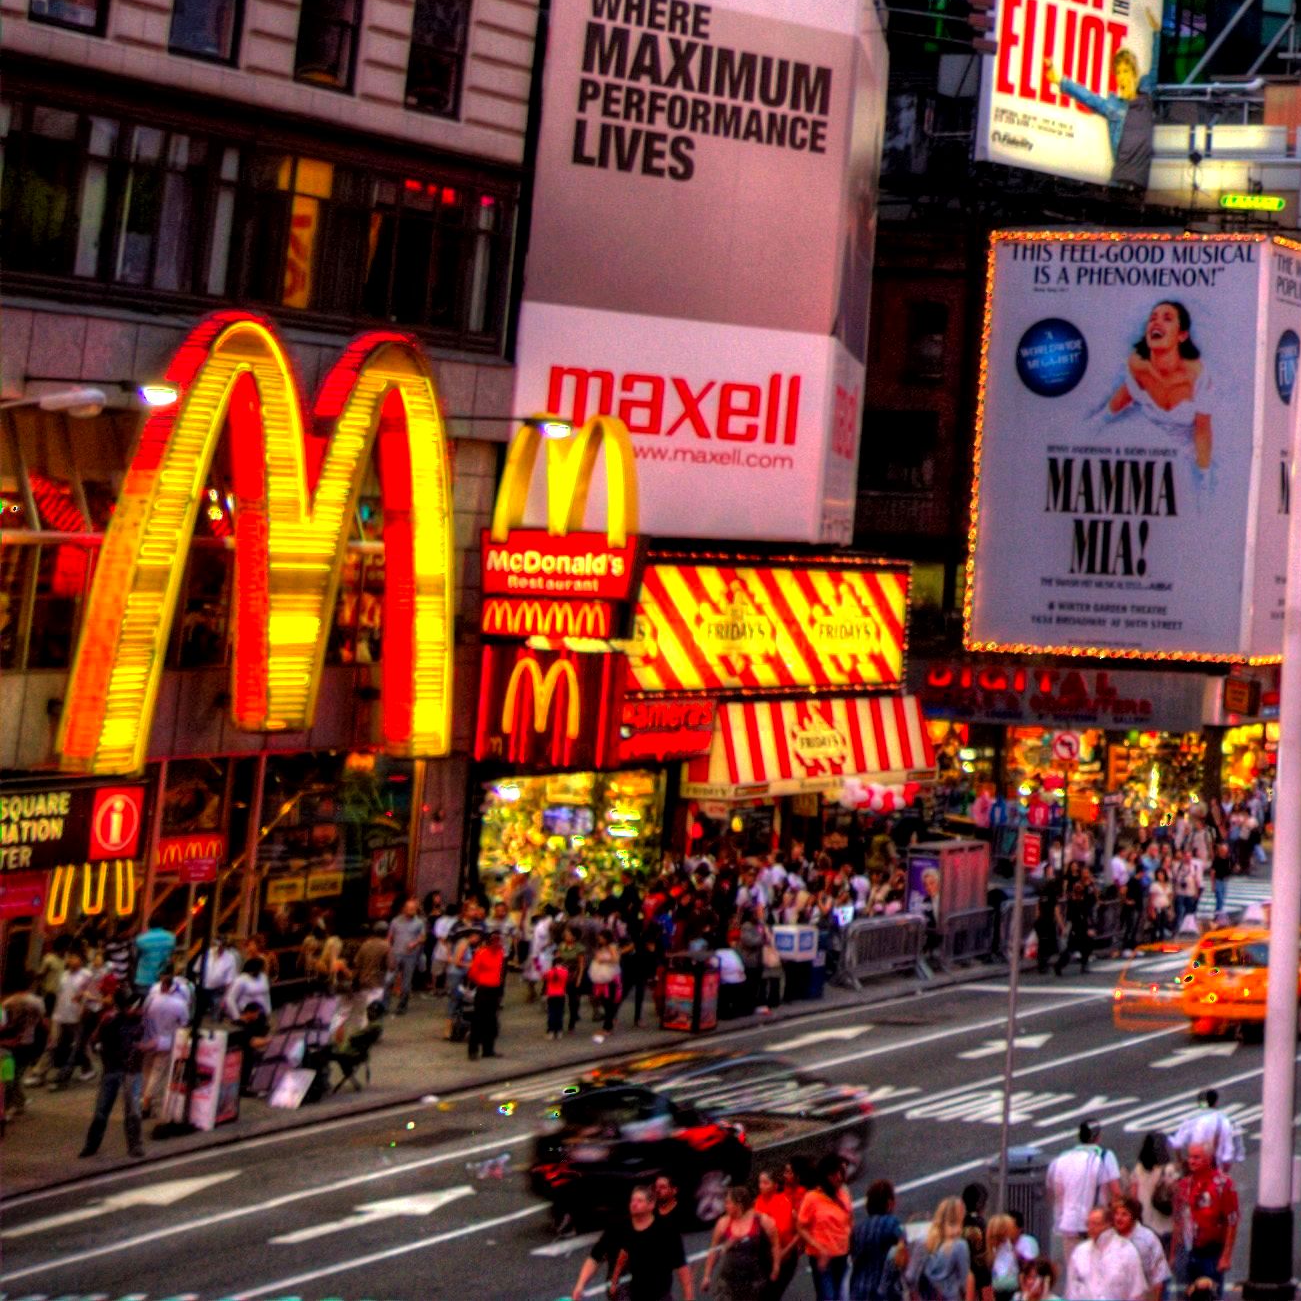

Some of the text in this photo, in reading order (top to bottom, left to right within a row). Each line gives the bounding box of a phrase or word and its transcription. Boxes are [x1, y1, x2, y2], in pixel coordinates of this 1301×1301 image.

[580, 21, 833, 117] MAXIMUM
[577, 77, 828, 155] PERFORMANCE
[572, 118, 696, 182] LIVES
[1033, 266, 1051, 285] IS
[1057, 266, 1070, 285] A
[1060, 244, 1165, 264] FEEL-GOOD
[1172, 245, 1256, 265] MUSICAL
[547, 365, 802, 447] maxell
[632, 445, 794, 470] ww.maxell.com
[1044, 457, 1179, 517] MAMMA
[485, 550, 625, 577] McDonald's
[1069, 518, 1150, 577] MIA!
[507, 574, 599, 593] Restaurant
[0, 793, 71, 819] SQUARE
